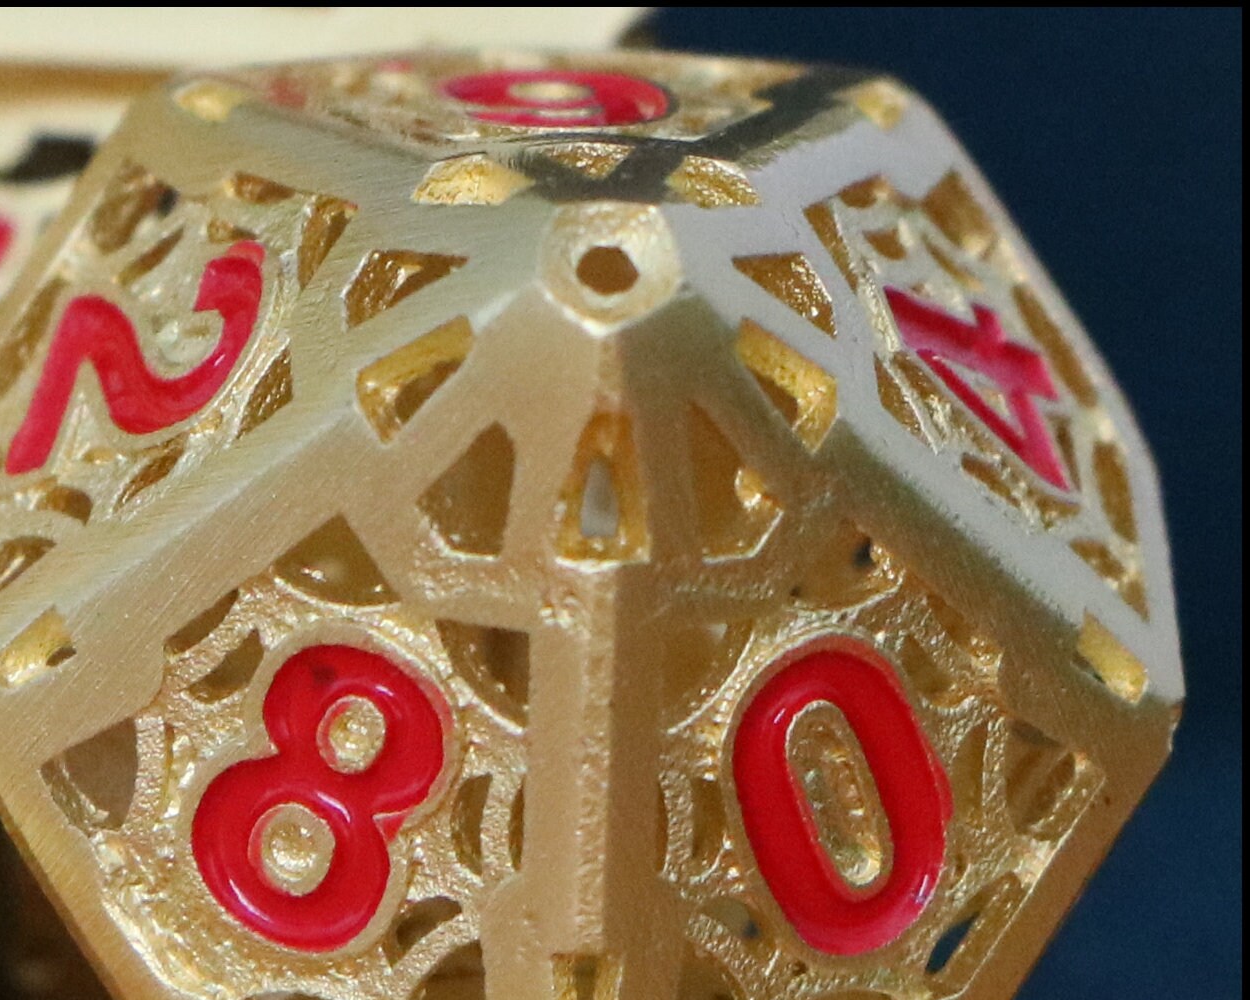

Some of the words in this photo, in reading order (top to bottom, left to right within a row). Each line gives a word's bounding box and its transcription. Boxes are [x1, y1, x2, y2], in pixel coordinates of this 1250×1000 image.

[7, 241, 264, 476] 2
[883, 285, 1070, 491] 4
[192, 643, 449, 953] 8
[734, 640, 953, 957] 0
